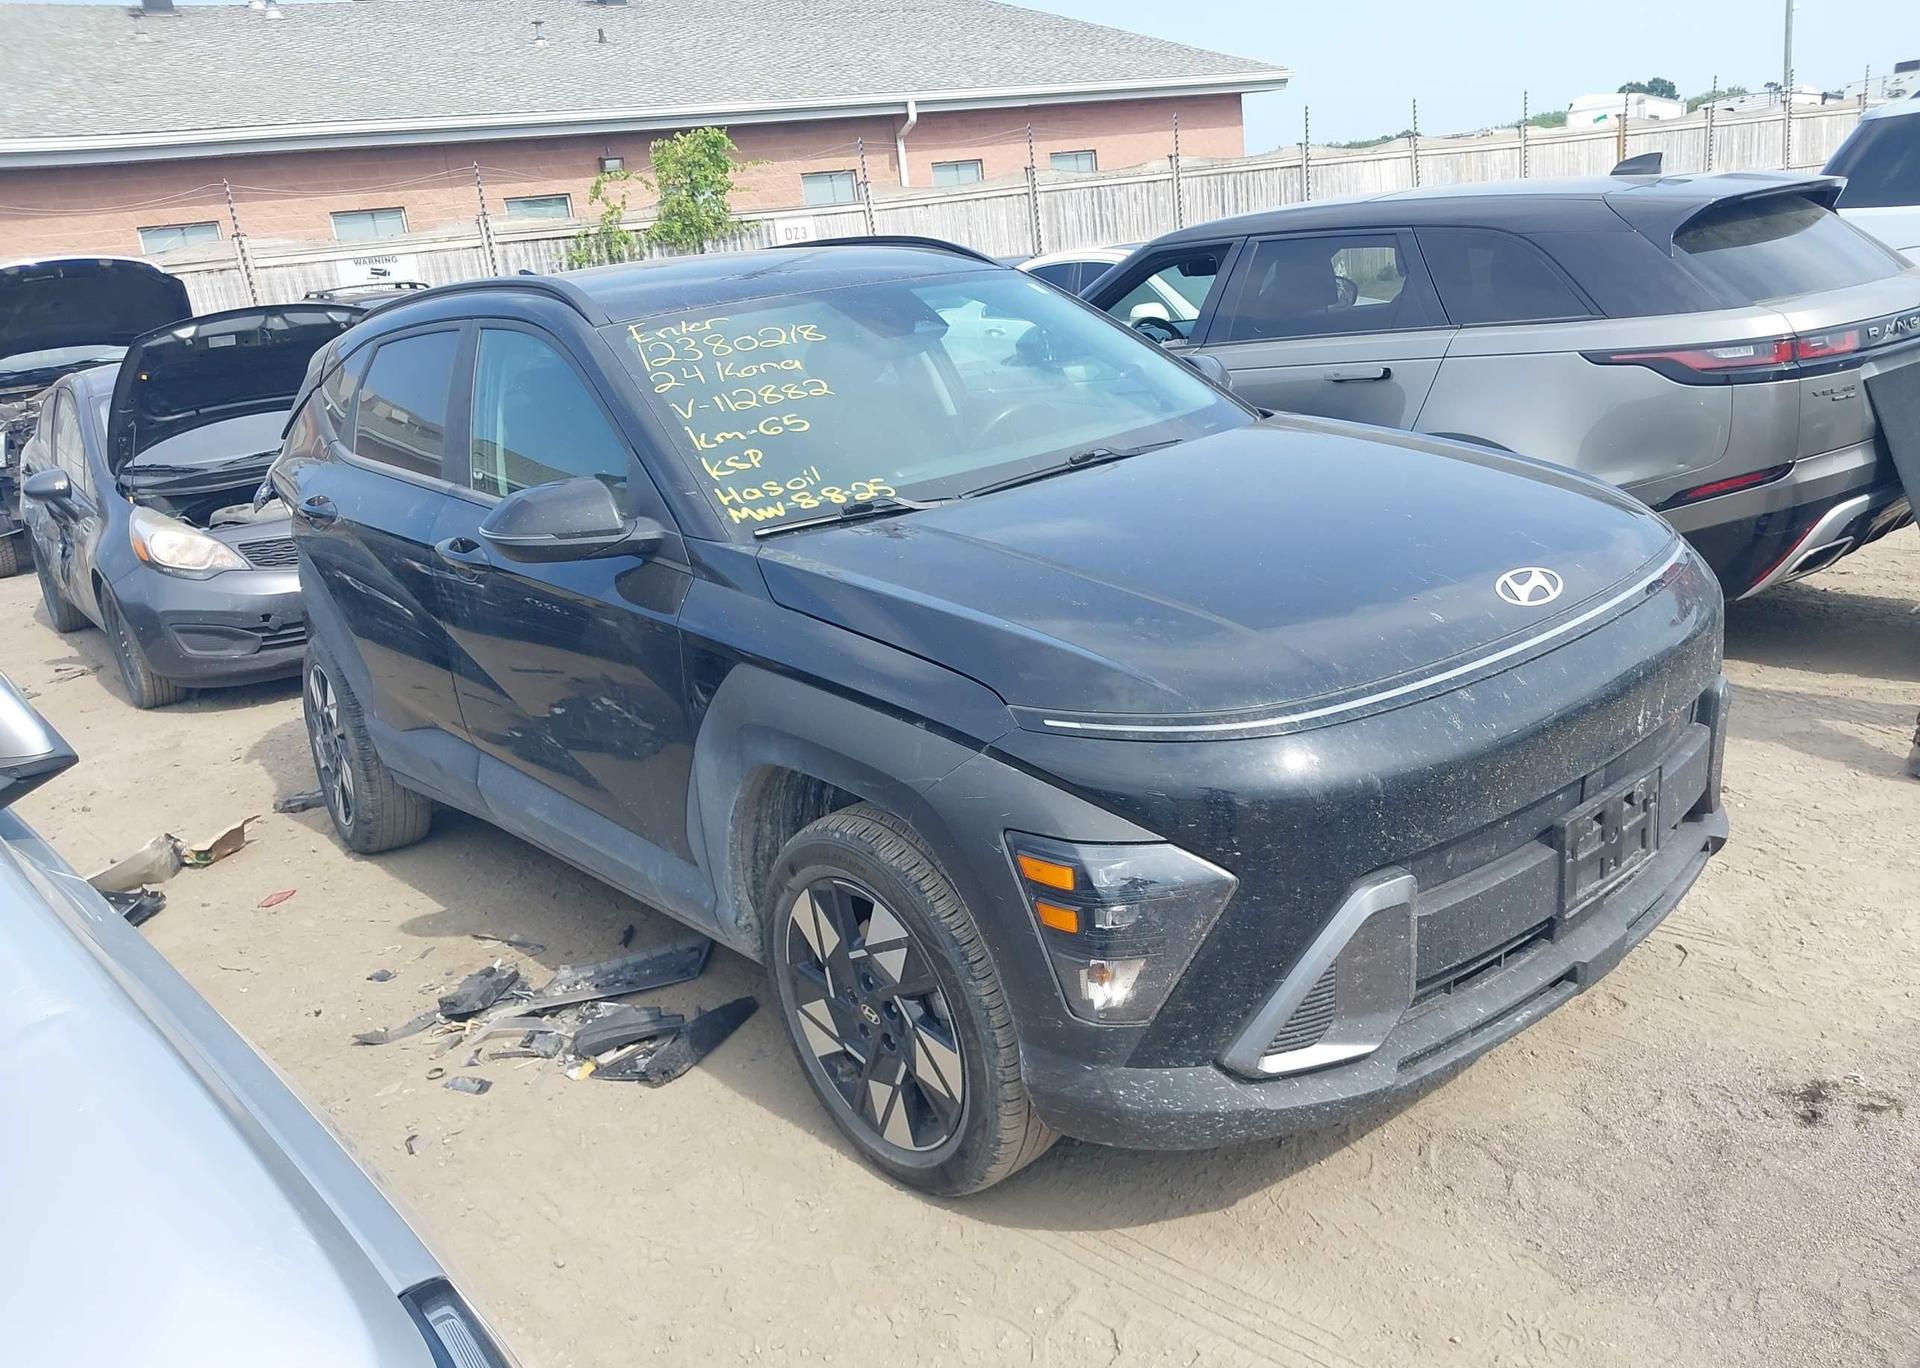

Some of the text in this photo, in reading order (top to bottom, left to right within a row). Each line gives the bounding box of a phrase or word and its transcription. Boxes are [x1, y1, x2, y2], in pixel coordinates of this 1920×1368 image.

[353, 255, 398, 266] WARNING
[637, 324, 827, 371] 12380218
[649, 360, 803, 393] 24 Kona
